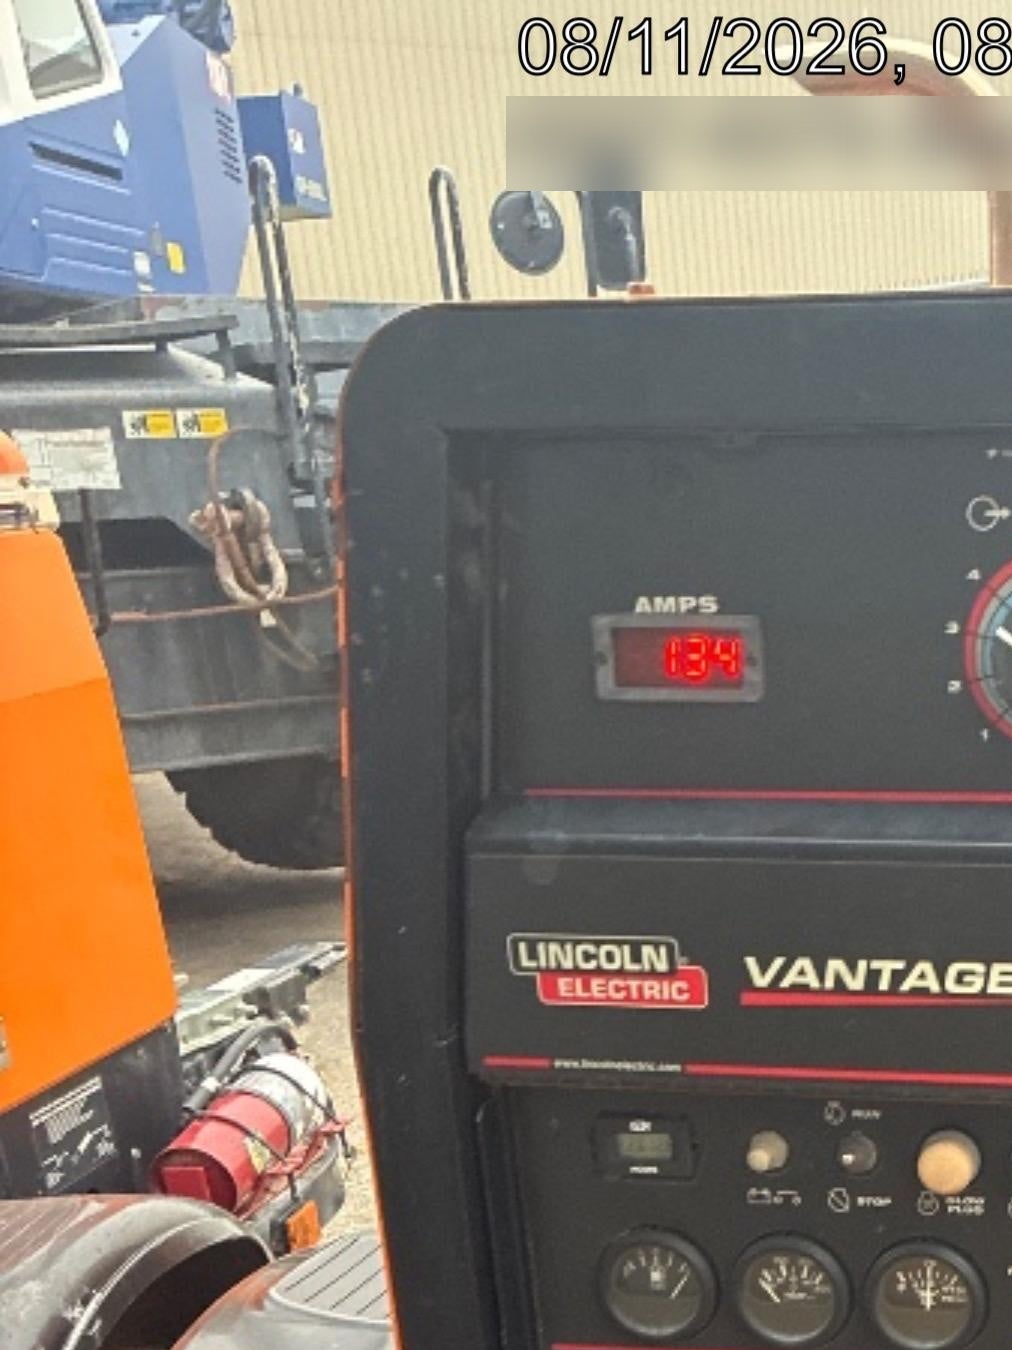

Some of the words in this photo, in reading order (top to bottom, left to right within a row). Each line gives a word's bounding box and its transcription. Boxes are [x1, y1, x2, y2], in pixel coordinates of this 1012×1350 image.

[965, 568, 981, 581] 4
[634, 596, 720, 613] AMPS
[980, 727, 989, 742] 1
[518, 941, 671, 973] LINCOLN
[556, 977, 691, 1002] ELECTRIC
[856, 1196, 892, 1208] STOP
